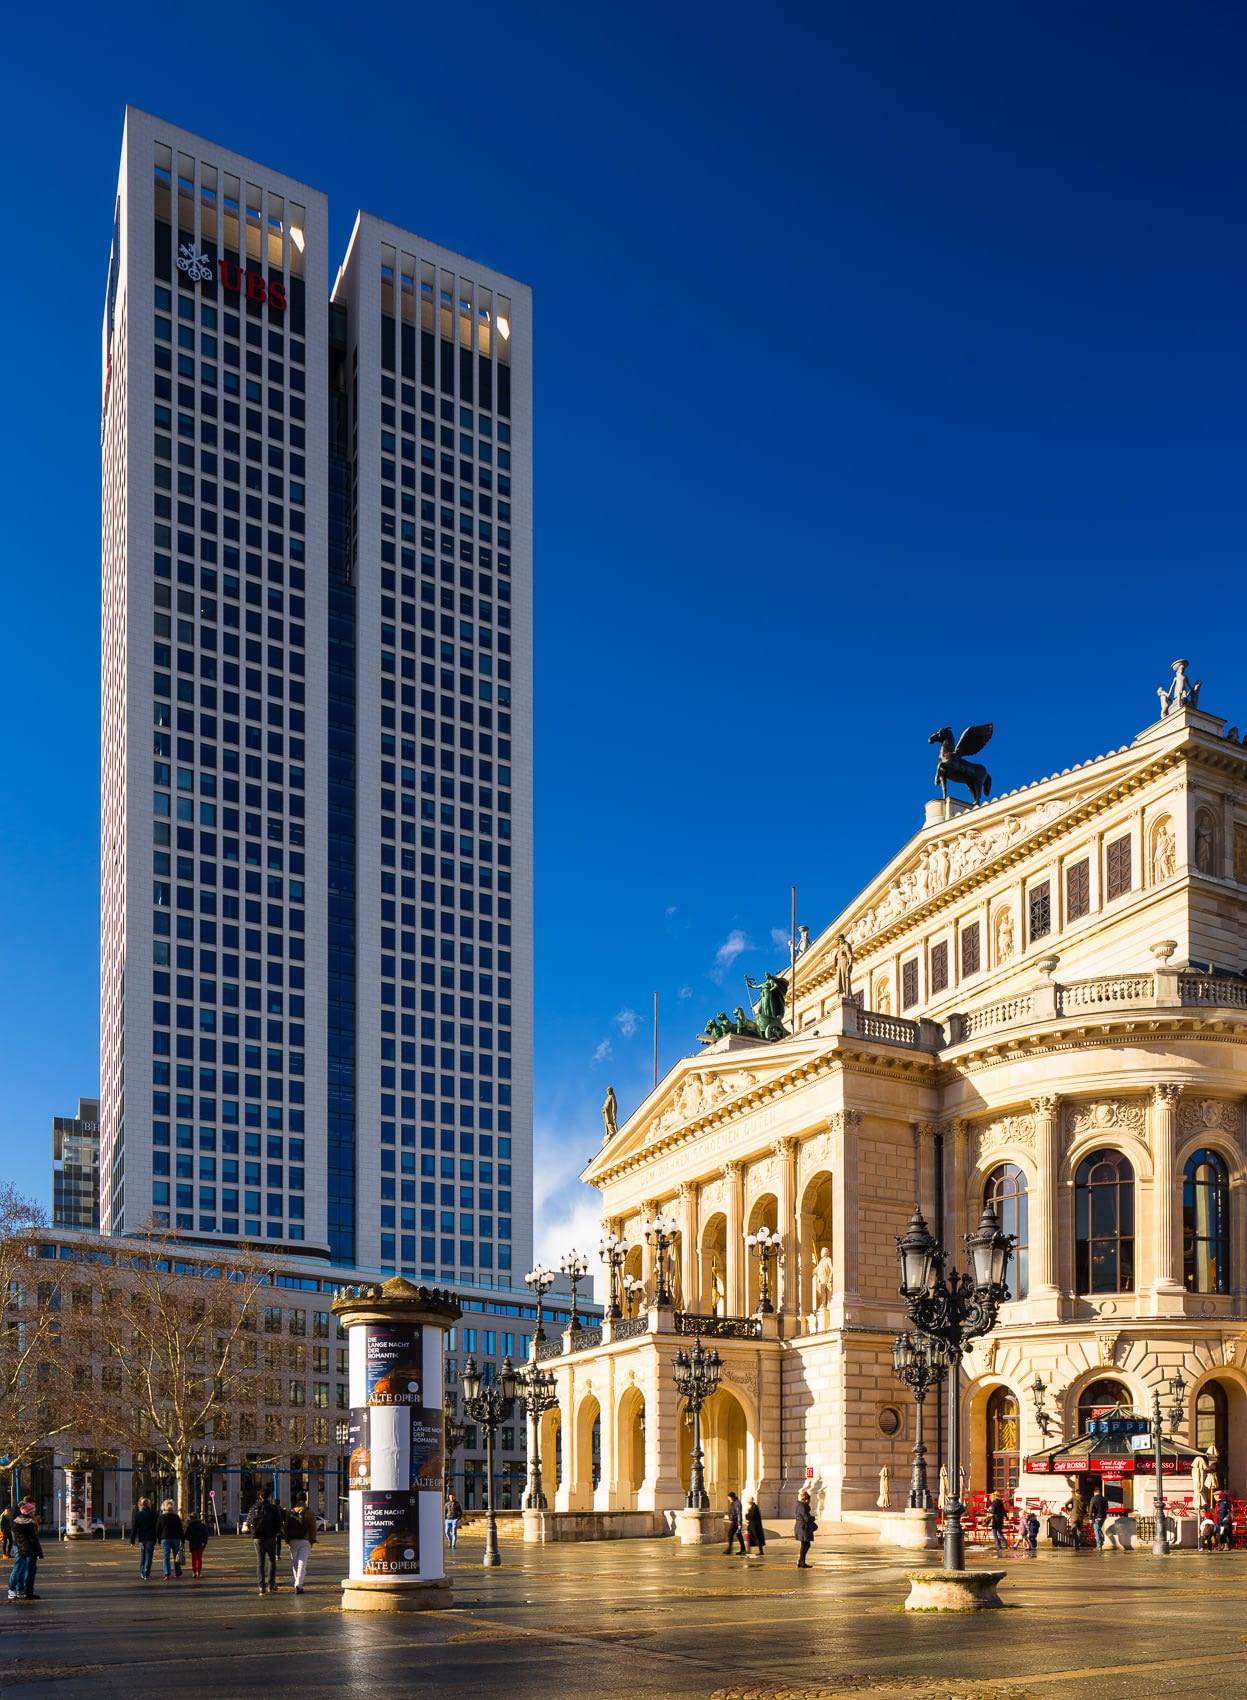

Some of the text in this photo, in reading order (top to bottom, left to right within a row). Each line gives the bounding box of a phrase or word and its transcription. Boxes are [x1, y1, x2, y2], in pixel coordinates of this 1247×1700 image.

[218, 258, 288, 312] UBS
[367, 1393, 420, 1403] ALTE OPER
[1066, 1461, 1087, 1469] ROSSO
[364, 1561, 417, 1570] ALTE OPER
